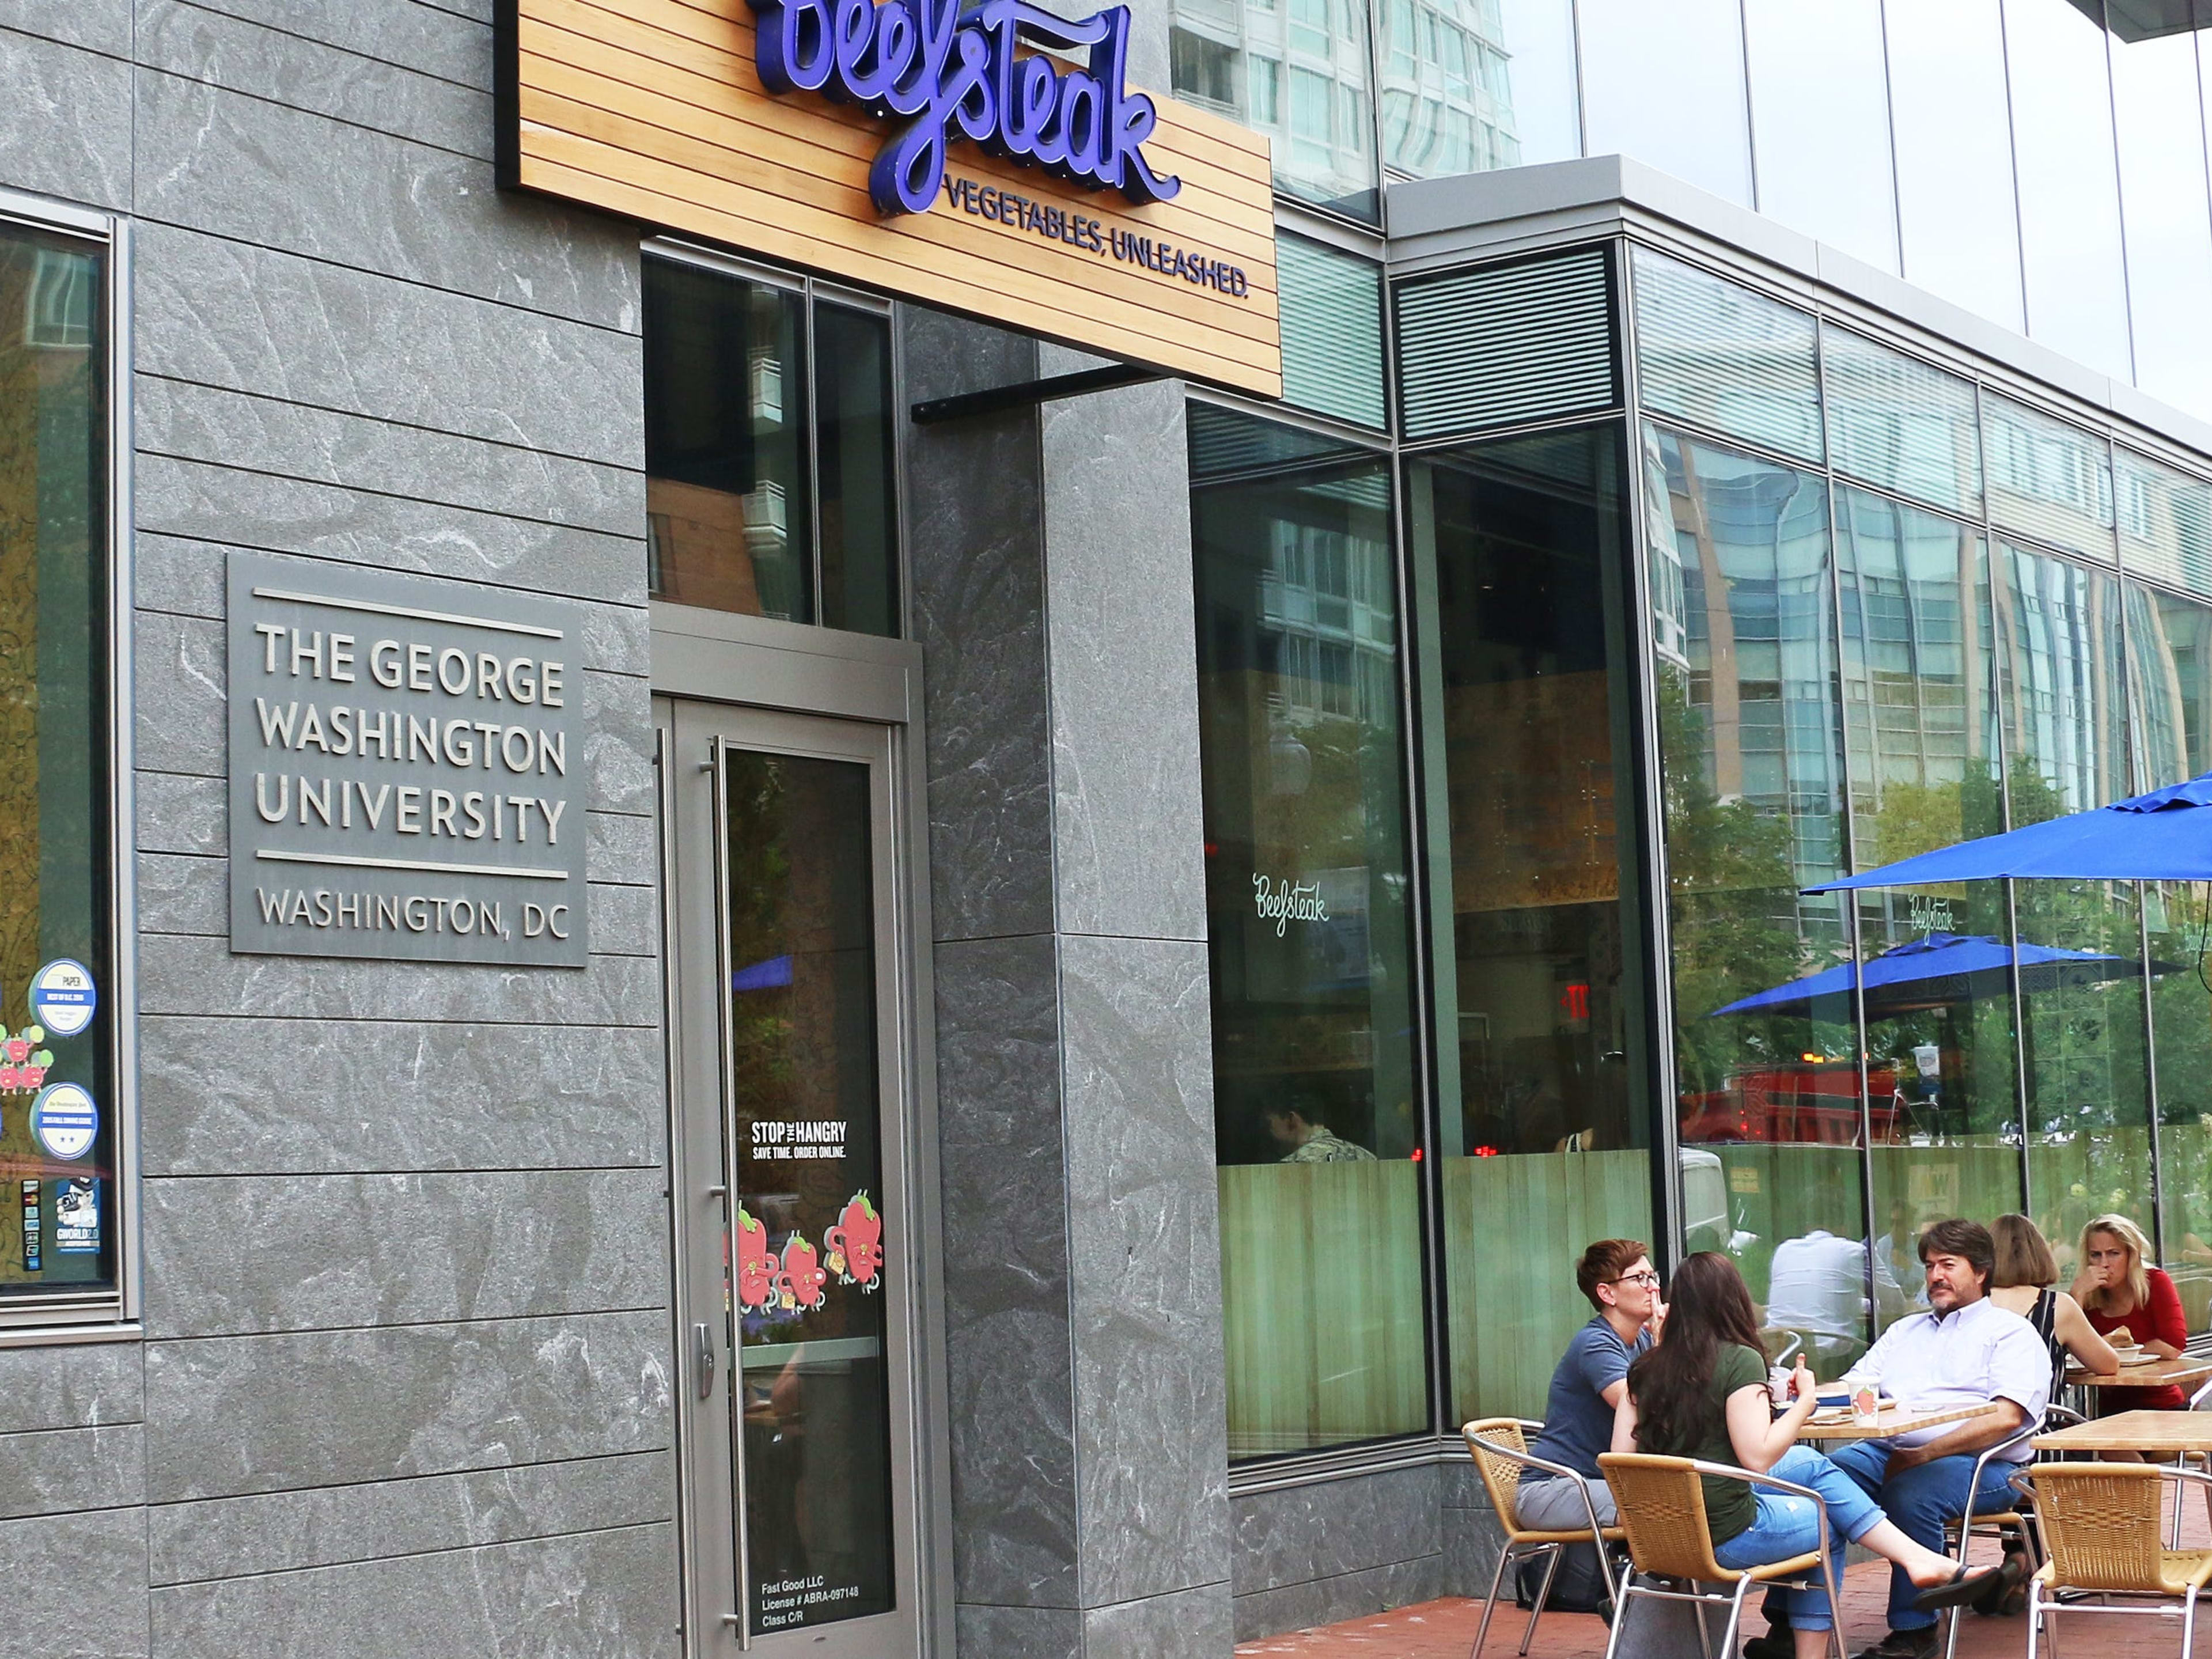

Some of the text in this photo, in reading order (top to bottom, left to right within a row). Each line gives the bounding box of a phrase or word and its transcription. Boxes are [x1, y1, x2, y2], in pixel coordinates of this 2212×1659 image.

[944, 173, 1249, 300] VEGETABLES, UNLEASHED.
[255, 623, 565, 708] THE GEORGE
[255, 697, 566, 776] WASHINGTON
[255, 772, 567, 844] UNIVERSITY
[256, 887, 570, 941] WASHINGTON, DC
[1252, 872, 1330, 938] Beefsteak
[1907, 893, 1956, 946] Beefsteak
[751, 1120, 847, 1144] STOP THE HANGRY
[752, 1145, 847, 1160] SAVE TIME. ORDER ONLINE.
[762, 1575, 824, 1595] Fast Good LLC
[762, 1586, 859, 1611] License # ABRA-097148
[762, 1610, 804, 1627] Class C/R
